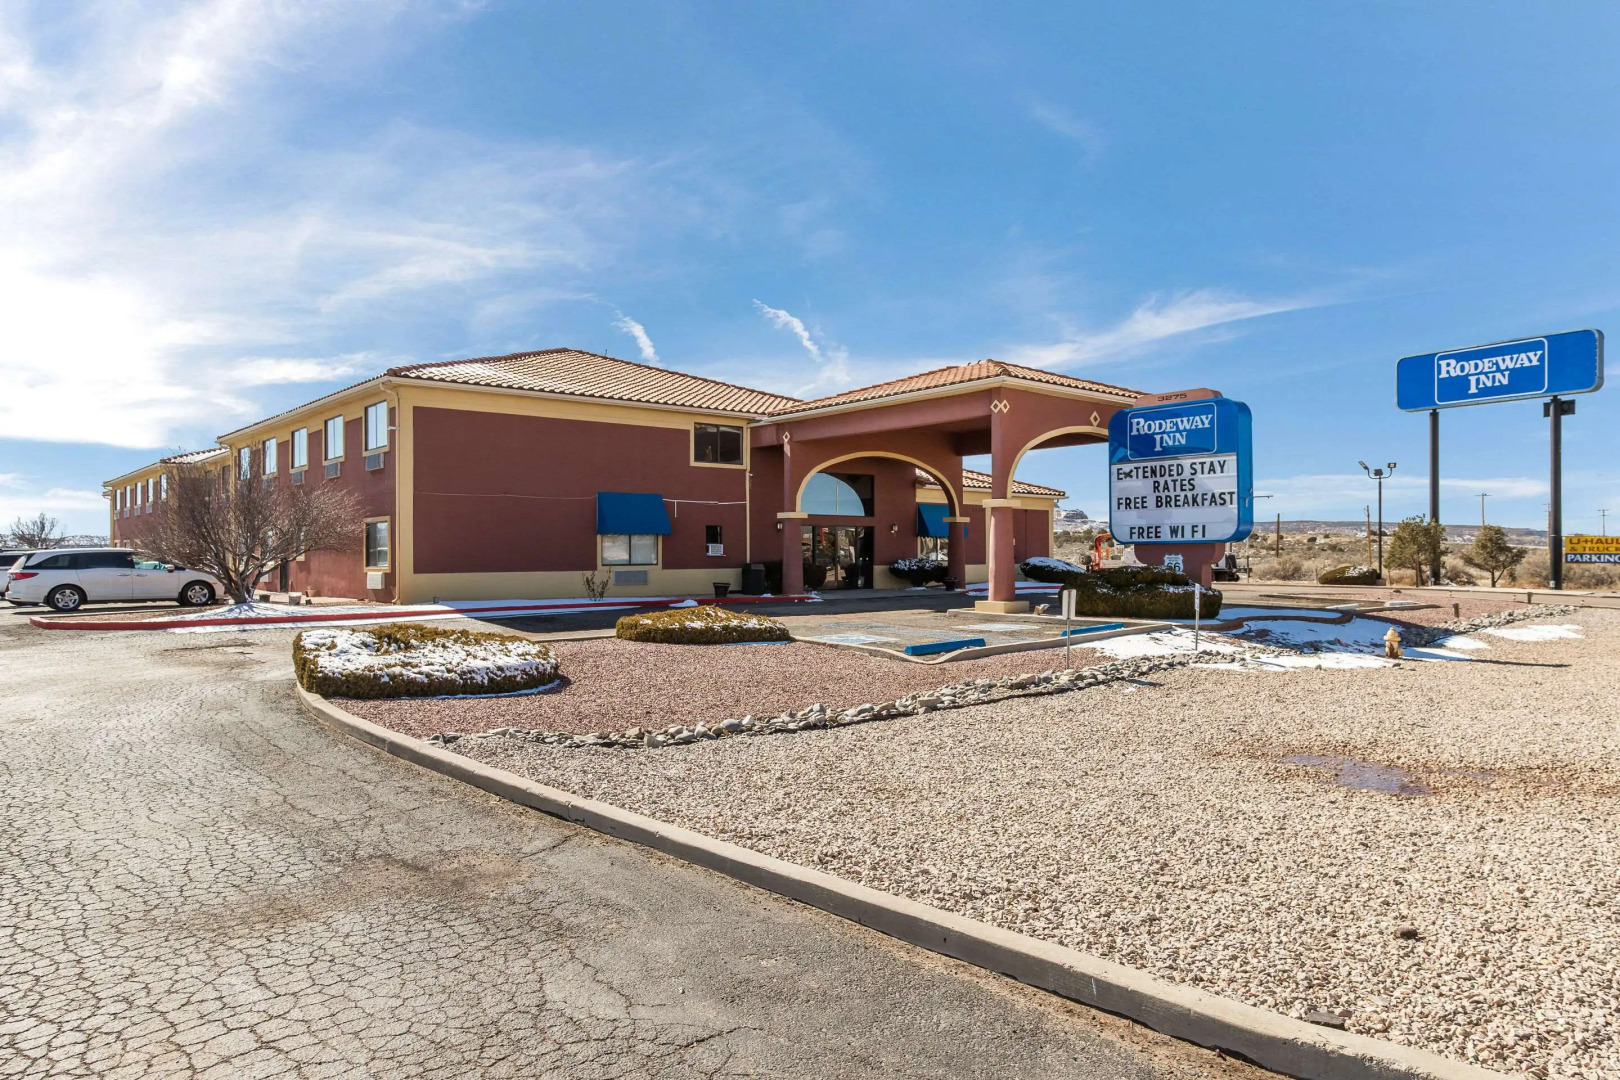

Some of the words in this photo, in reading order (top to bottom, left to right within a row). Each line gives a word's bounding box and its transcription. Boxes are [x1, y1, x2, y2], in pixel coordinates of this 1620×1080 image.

[1439, 351, 1543, 378] RODEWAY
[1468, 371, 1510, 394] INN
[1157, 392, 1187, 401] 3275
[1131, 414, 1213, 436] RODEWAY
[1154, 432, 1187, 451] INN
[1189, 460, 1227, 476] STAY
[1153, 478, 1196, 493] RATES
[1117, 496, 1148, 510] FREE
[1155, 491, 1236, 508] BREAKFAST
[1129, 525, 1162, 540] FREE
